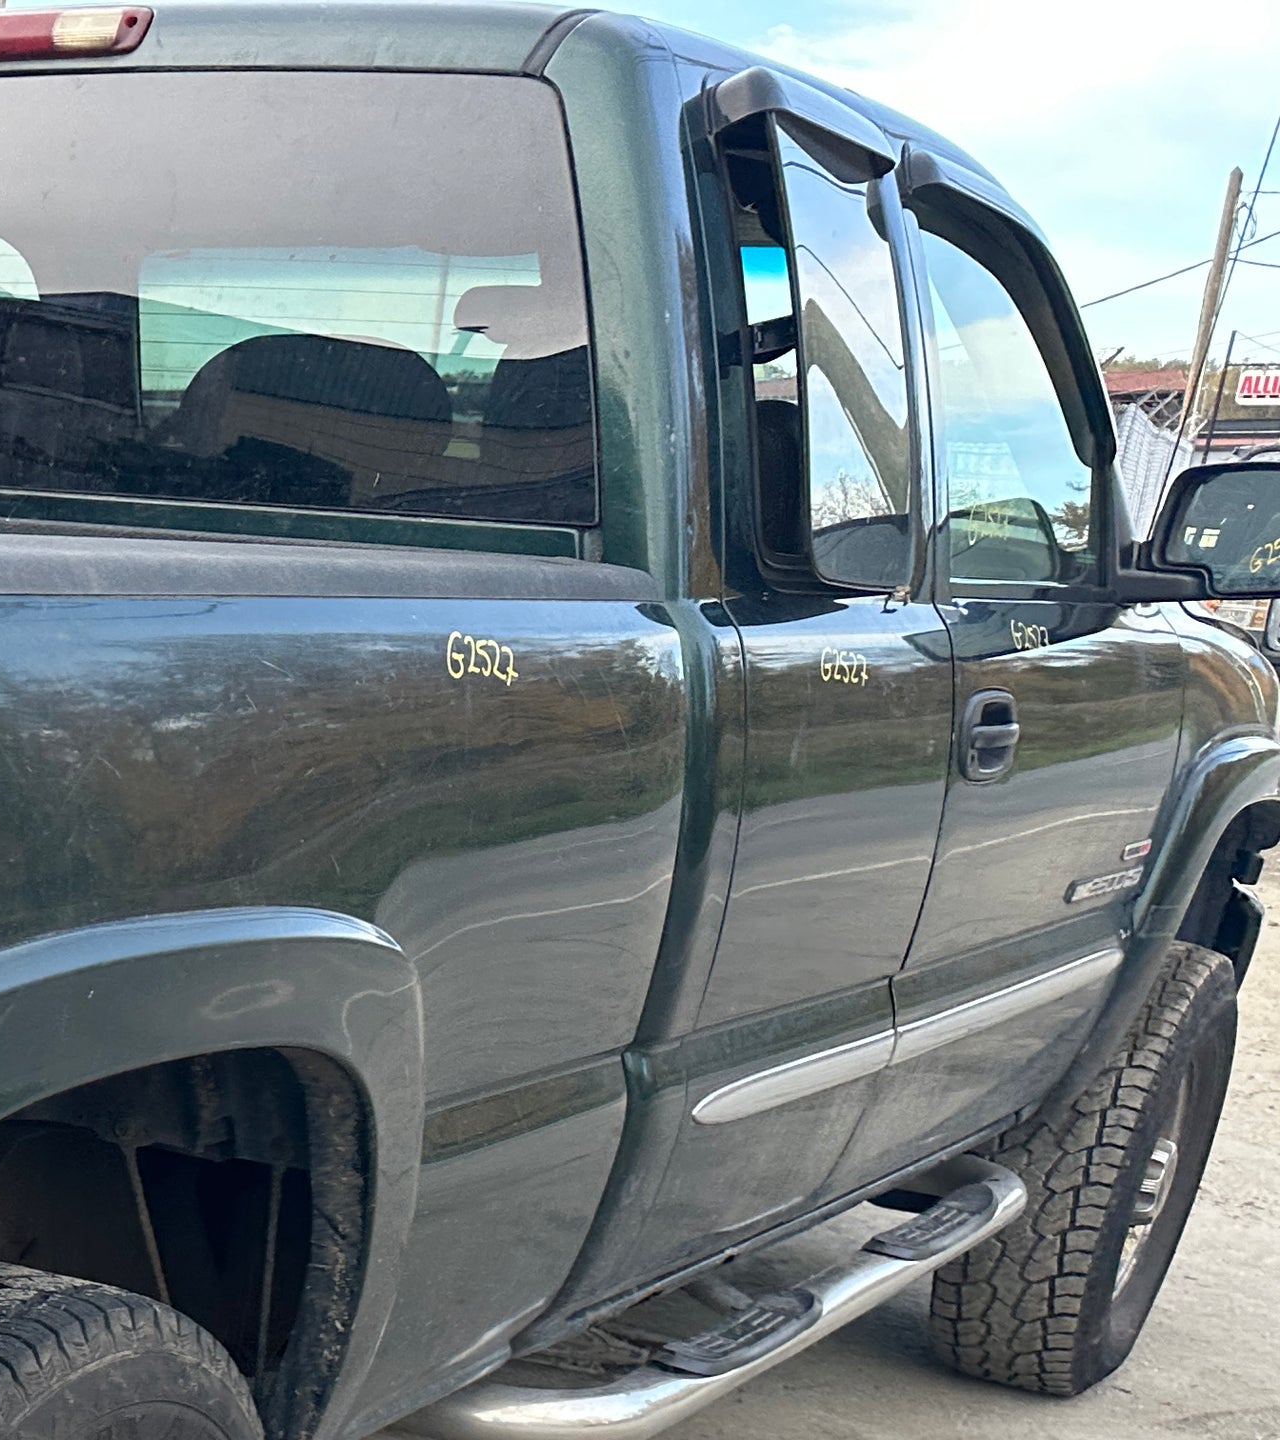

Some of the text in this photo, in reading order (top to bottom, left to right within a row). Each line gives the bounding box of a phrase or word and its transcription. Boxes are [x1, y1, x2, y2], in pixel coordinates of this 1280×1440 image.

[1239, 375, 1280, 395] ALLI
[446, 630, 520, 687] G2527
[820, 645, 870, 688] G2527
